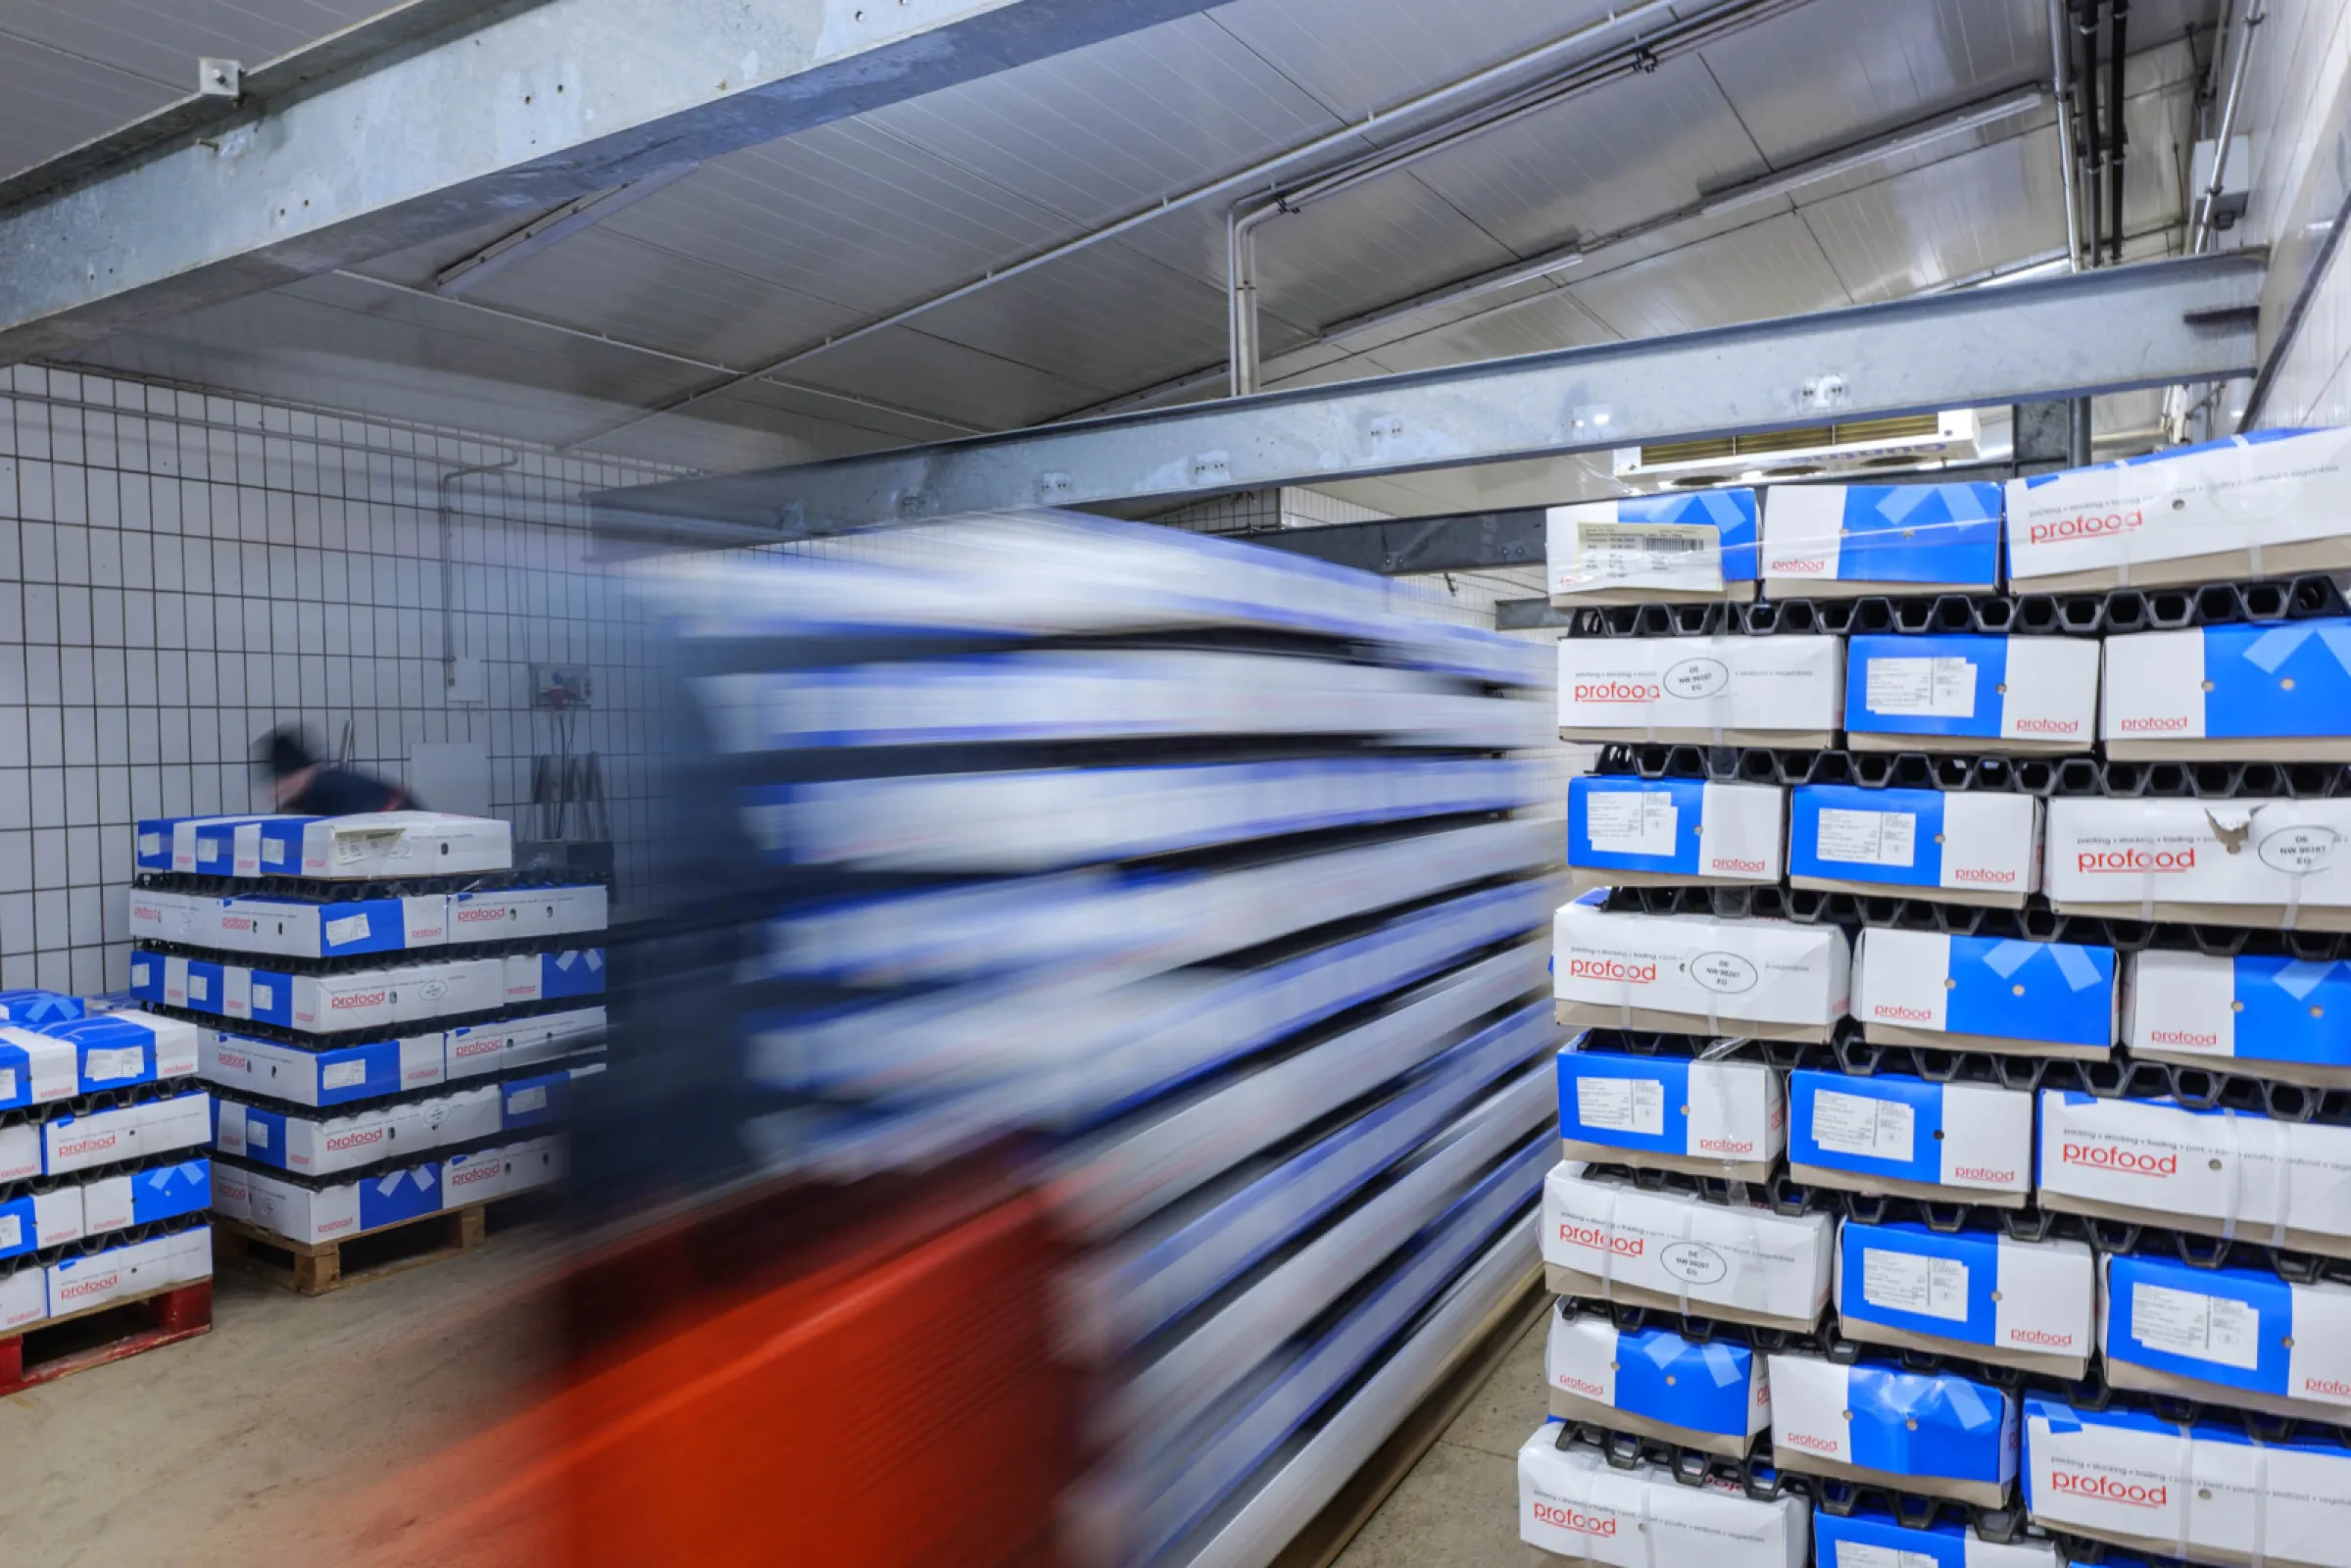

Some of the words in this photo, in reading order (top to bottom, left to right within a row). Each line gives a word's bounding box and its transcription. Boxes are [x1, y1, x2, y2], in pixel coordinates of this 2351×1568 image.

[2030, 507, 2143, 546] profood
[1771, 559, 1825, 571] profood
[1574, 682, 1661, 704] profood
[2016, 718, 2079, 733] profood
[2121, 715, 2188, 732] profood
[1711, 858, 1766, 872] profood
[2078, 848, 2195, 873] profood
[1954, 868, 2016, 883] profood
[457, 906, 506, 923] profood
[1569, 958, 1656, 985] profood
[330, 992, 386, 1009] profood
[1874, 1004, 1932, 1021] profood
[2150, 1030, 2218, 1048] profood
[58, 1136, 117, 1157] profood
[325, 1128, 383, 1152] profood
[1699, 1139, 1754, 1154] profood
[2063, 1144, 2178, 1178] profood
[452, 1162, 501, 1187] profood
[1954, 1167, 2016, 1184] profood
[1559, 1223, 1644, 1257] profood
[60, 1274, 118, 1300] profood
[2010, 1329, 2073, 1347] profood
[1560, 1374, 1604, 1396] profood
[1788, 1432, 1837, 1451] profood
[2052, 1471, 2168, 1508] profood
[1534, 1501, 1616, 1538] profood
